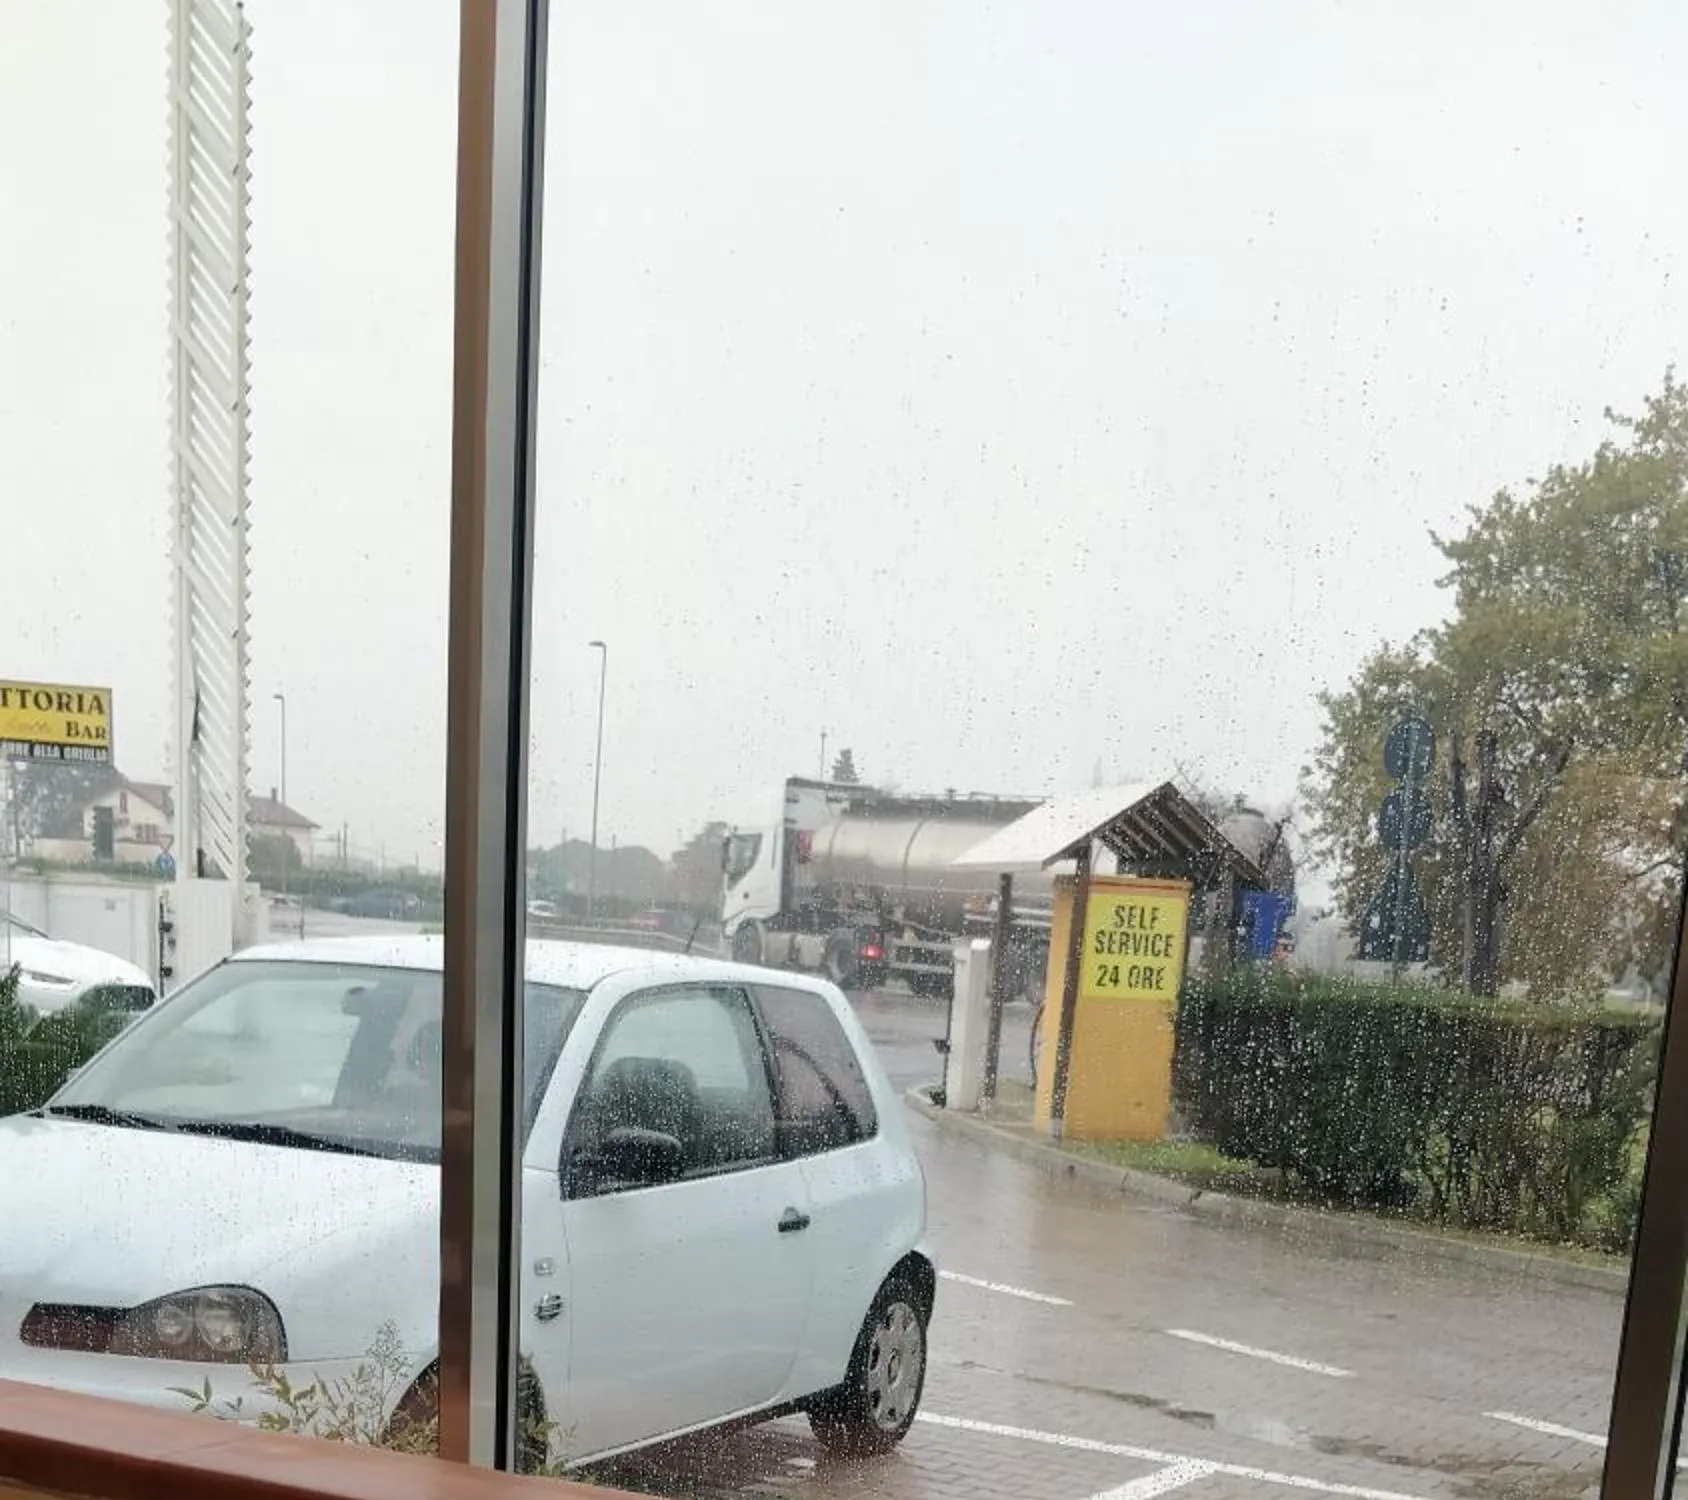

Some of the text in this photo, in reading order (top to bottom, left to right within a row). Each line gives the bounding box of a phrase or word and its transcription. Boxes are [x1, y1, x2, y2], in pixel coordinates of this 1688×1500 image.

[1114, 905, 1160, 930] SELF
[1094, 930, 1175, 958] SERVICE
[1095, 965, 1167, 991] 24 ORE
